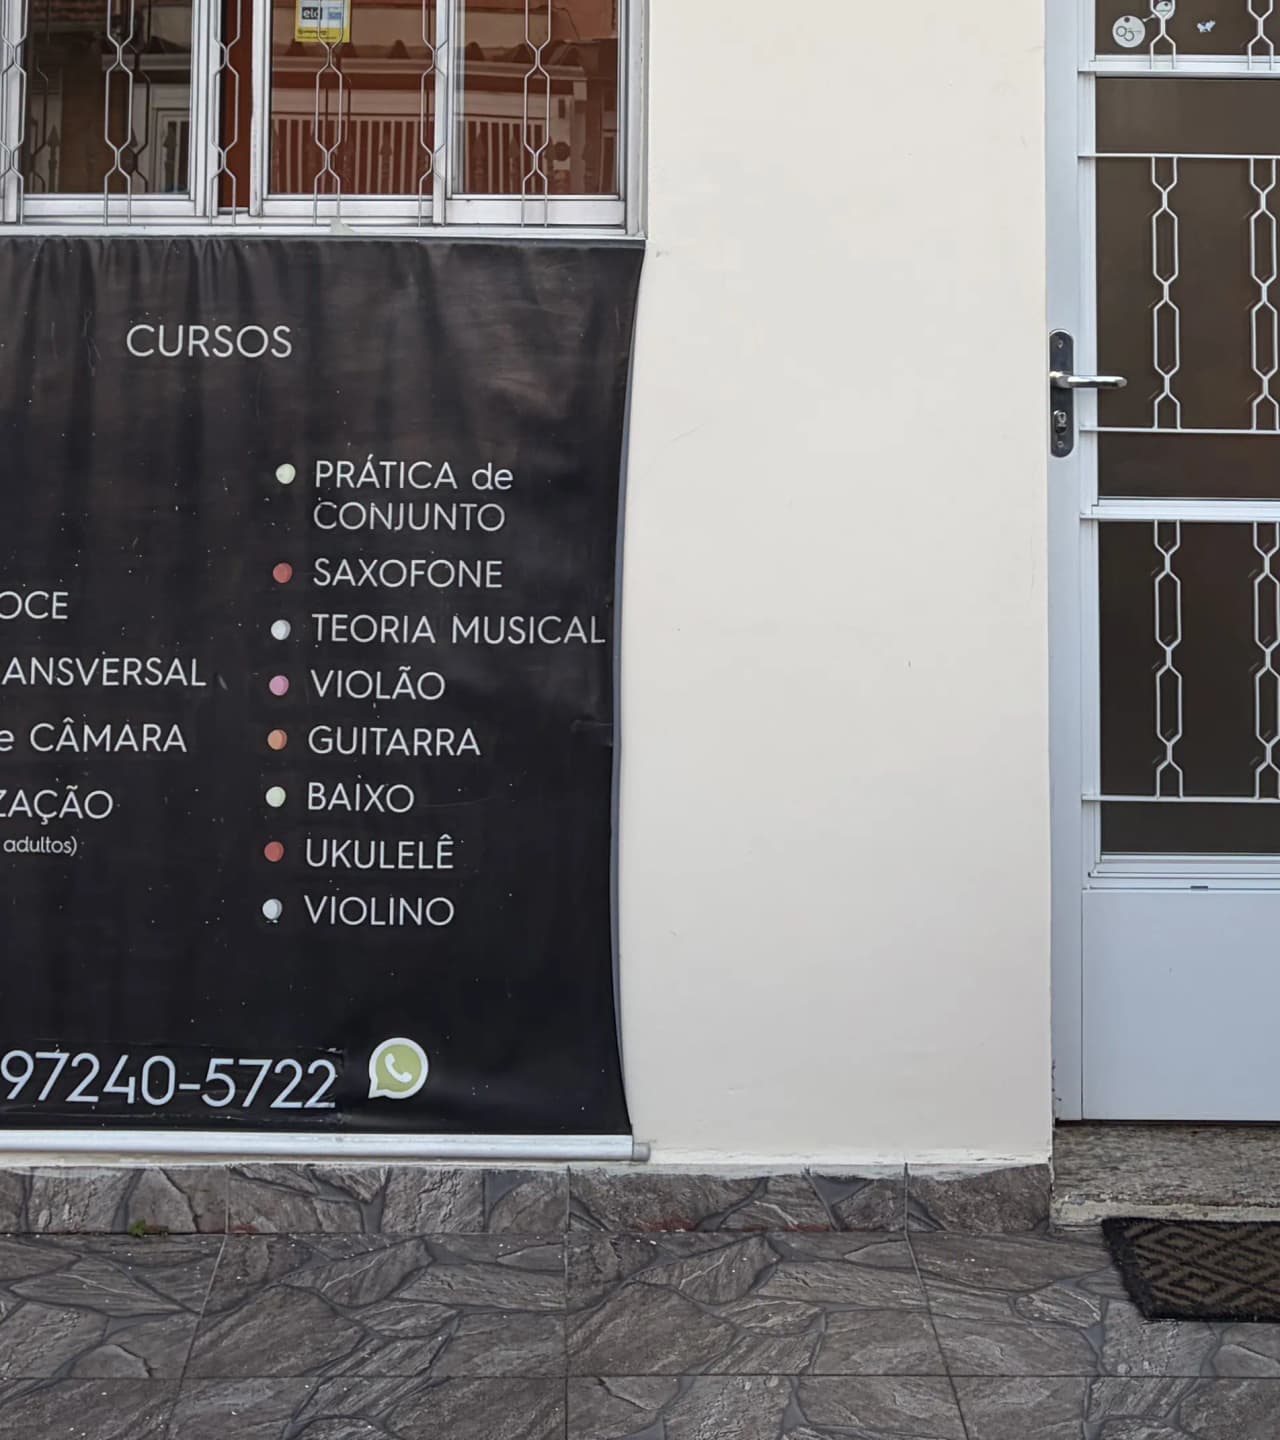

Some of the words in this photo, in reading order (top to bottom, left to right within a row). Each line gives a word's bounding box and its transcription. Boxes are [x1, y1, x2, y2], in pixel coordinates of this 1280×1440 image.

[126, 324, 292, 358] CURSOS
[315, 453, 458, 489] PRÁTICA
[471, 462, 513, 490] de
[313, 501, 505, 532] CONJUNTO
[313, 558, 503, 588] SAXOFONE
[311, 613, 436, 644] TEORIA
[452, 615, 606, 645] MUSICAL
[310, 665, 445, 700] VIOLÃO
[30, 716, 187, 753] CÂMARA
[308, 725, 481, 756] GUITARRA
[308, 782, 415, 813] BAIXO
[3, 835, 78, 857] adultos)
[306, 833, 454, 869] UKULELÊ
[303, 895, 455, 926] VIOLINO
[0, 1047, 338, 1108] 97240-5722
